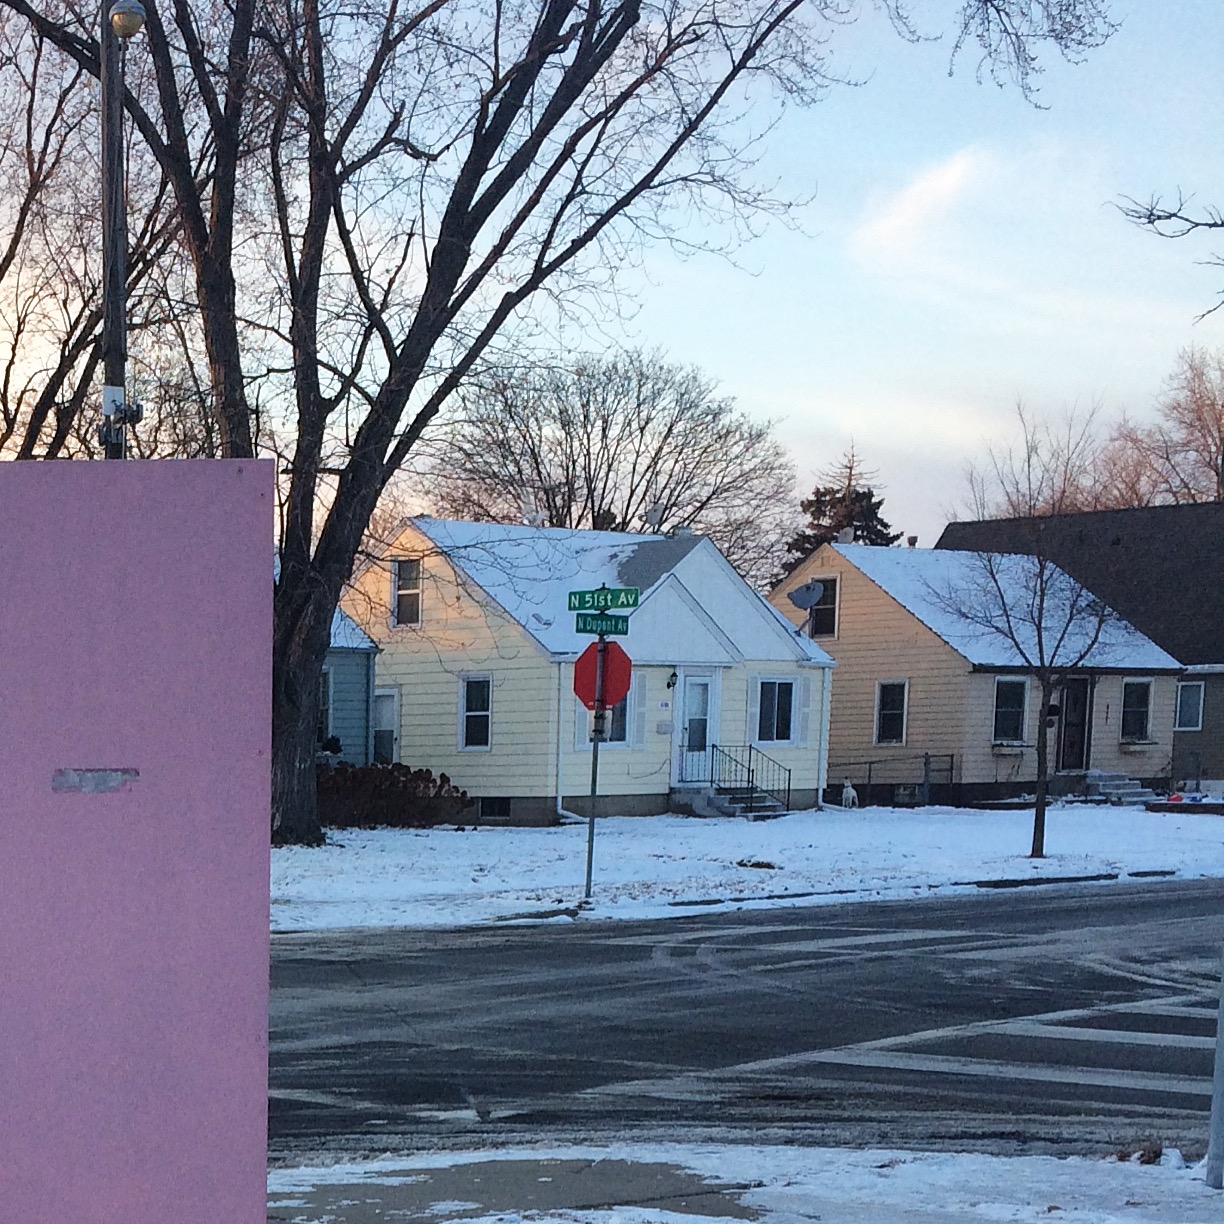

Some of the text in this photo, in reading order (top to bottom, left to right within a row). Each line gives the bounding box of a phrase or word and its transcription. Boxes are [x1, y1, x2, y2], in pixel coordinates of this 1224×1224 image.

[571, 592, 635, 608] N 51st Av
[577, 617, 627, 633] N Dupont Av
